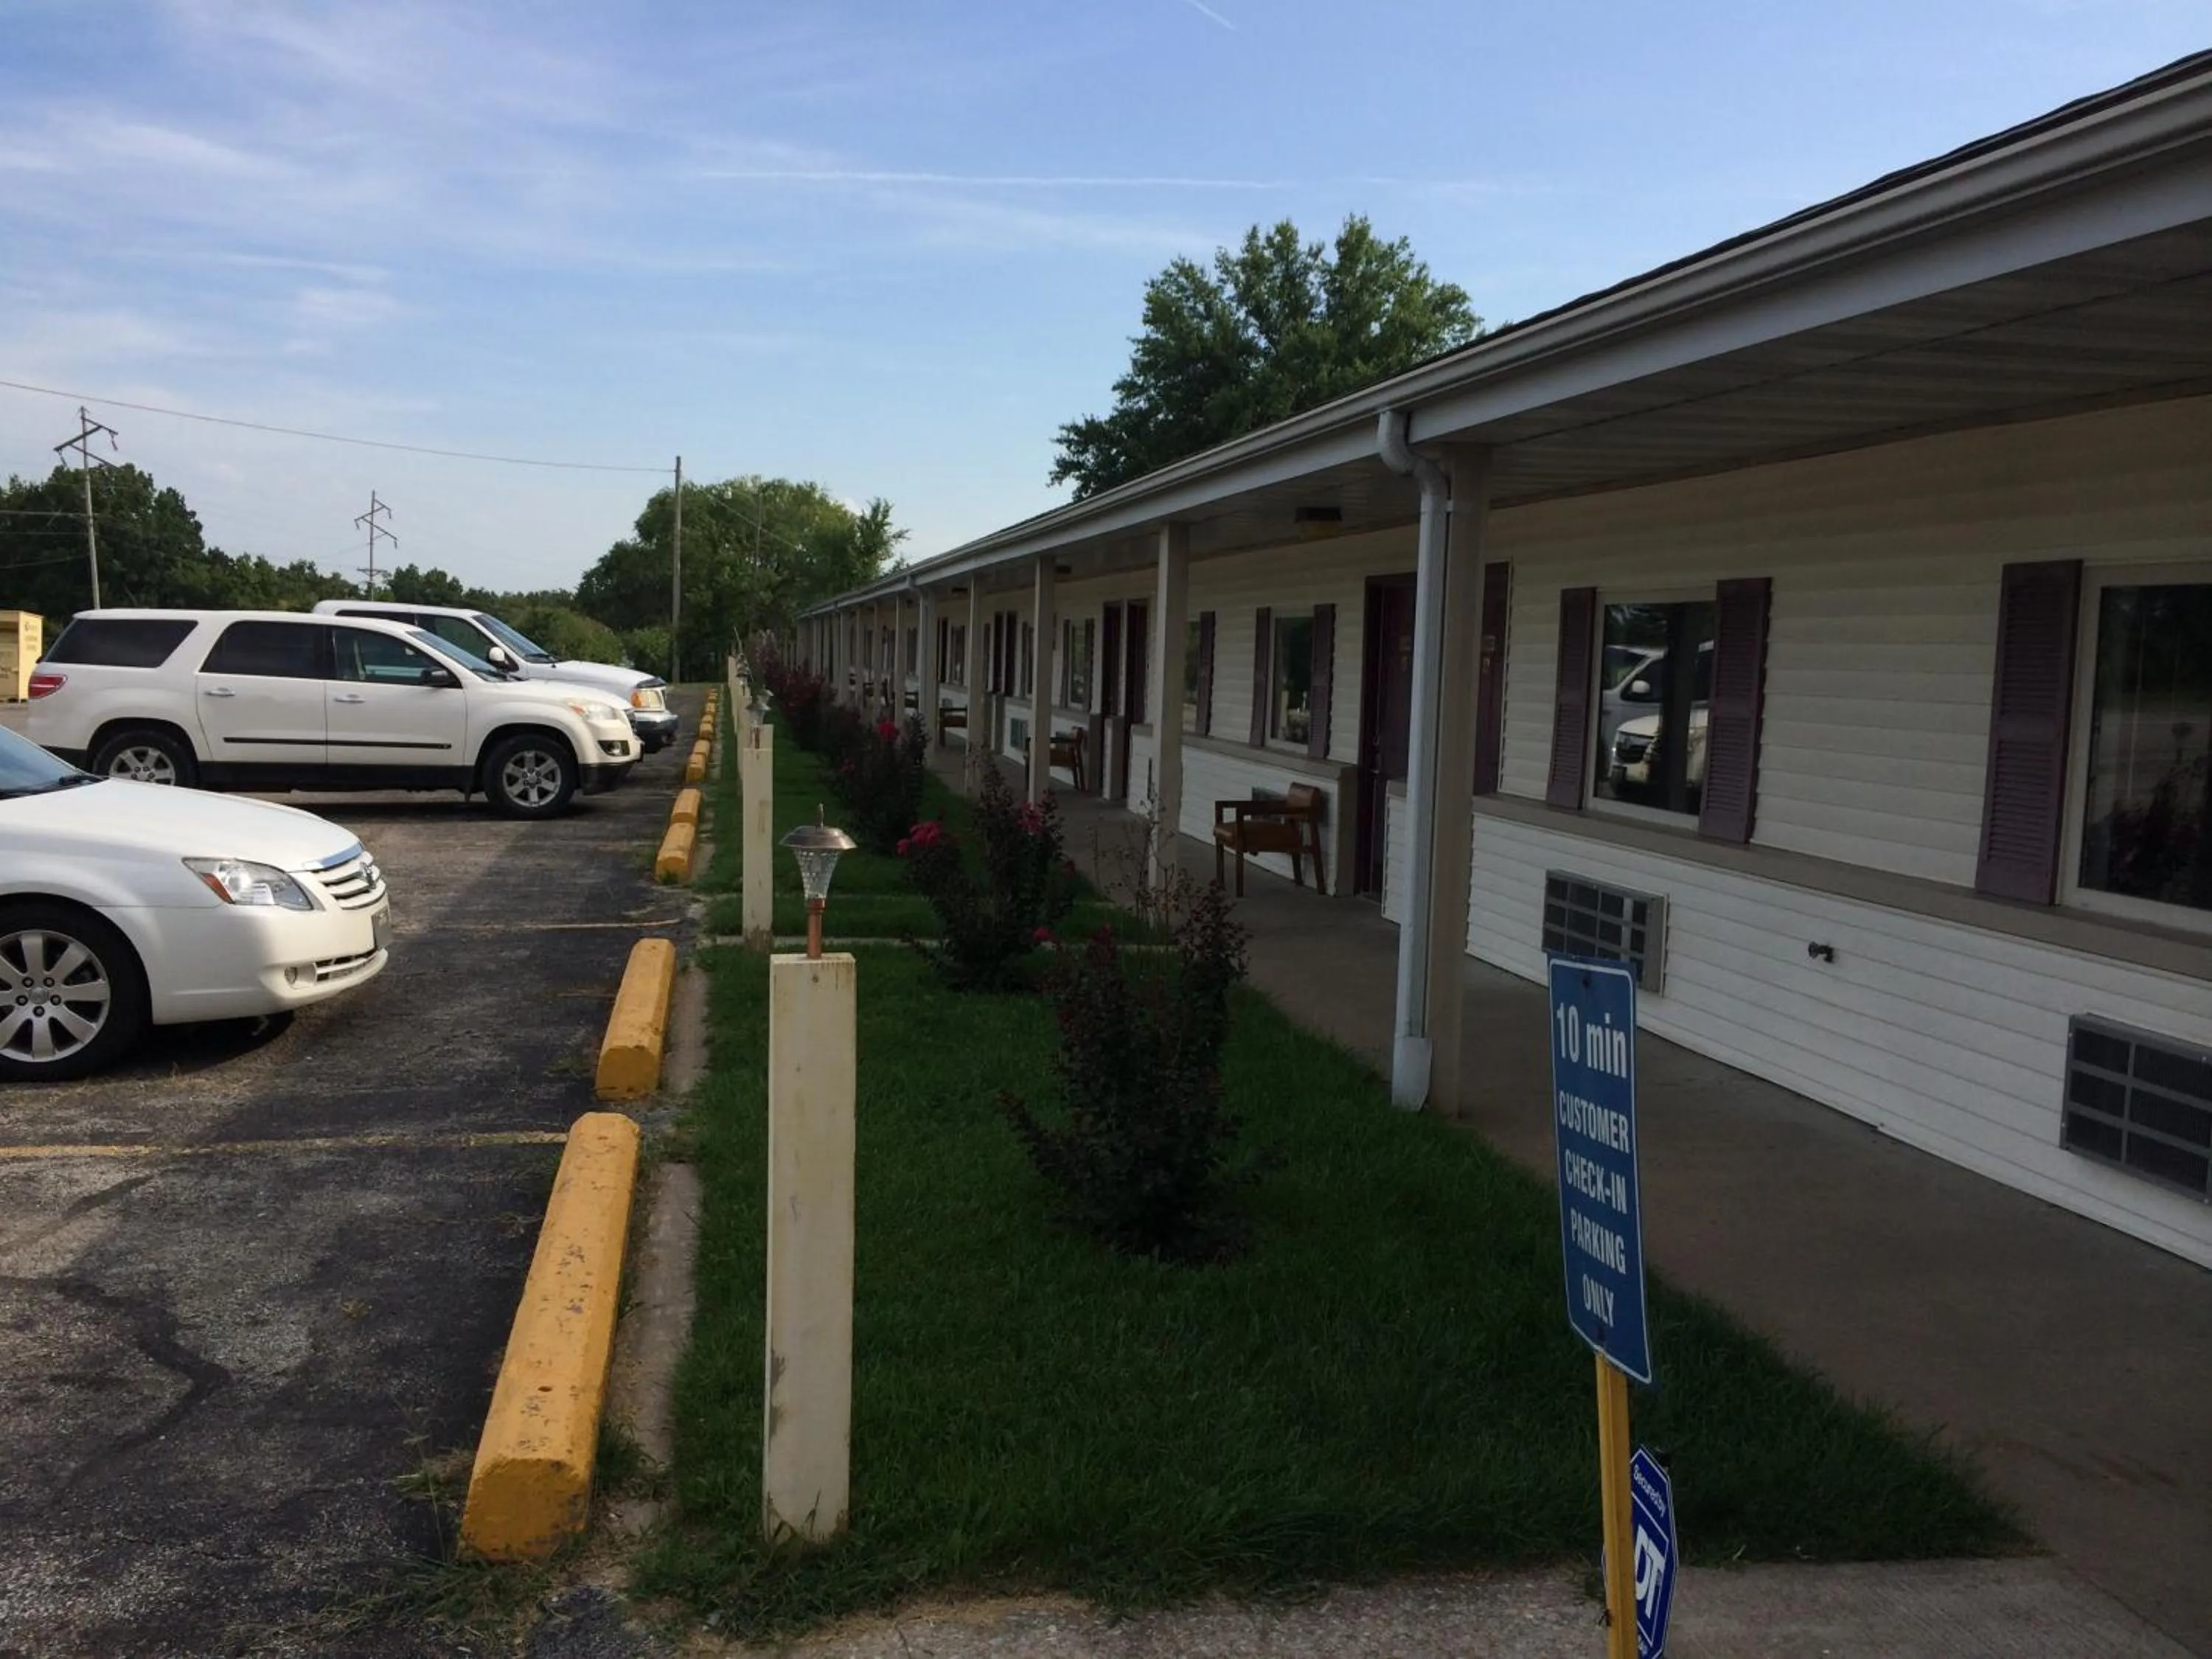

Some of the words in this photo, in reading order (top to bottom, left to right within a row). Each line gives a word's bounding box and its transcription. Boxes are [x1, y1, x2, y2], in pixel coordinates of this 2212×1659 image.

[1557, 1002, 1579, 1062] 10
[1586, 1012, 1627, 1078] min
[1559, 1091, 1629, 1153] CUSTOMER
[1565, 1149, 1627, 1214] CHECK-IN
[1571, 1208, 1626, 1274] PARKING
[1582, 1274, 1614, 1327] ONLY
[1635, 1523, 1665, 1619] DT
